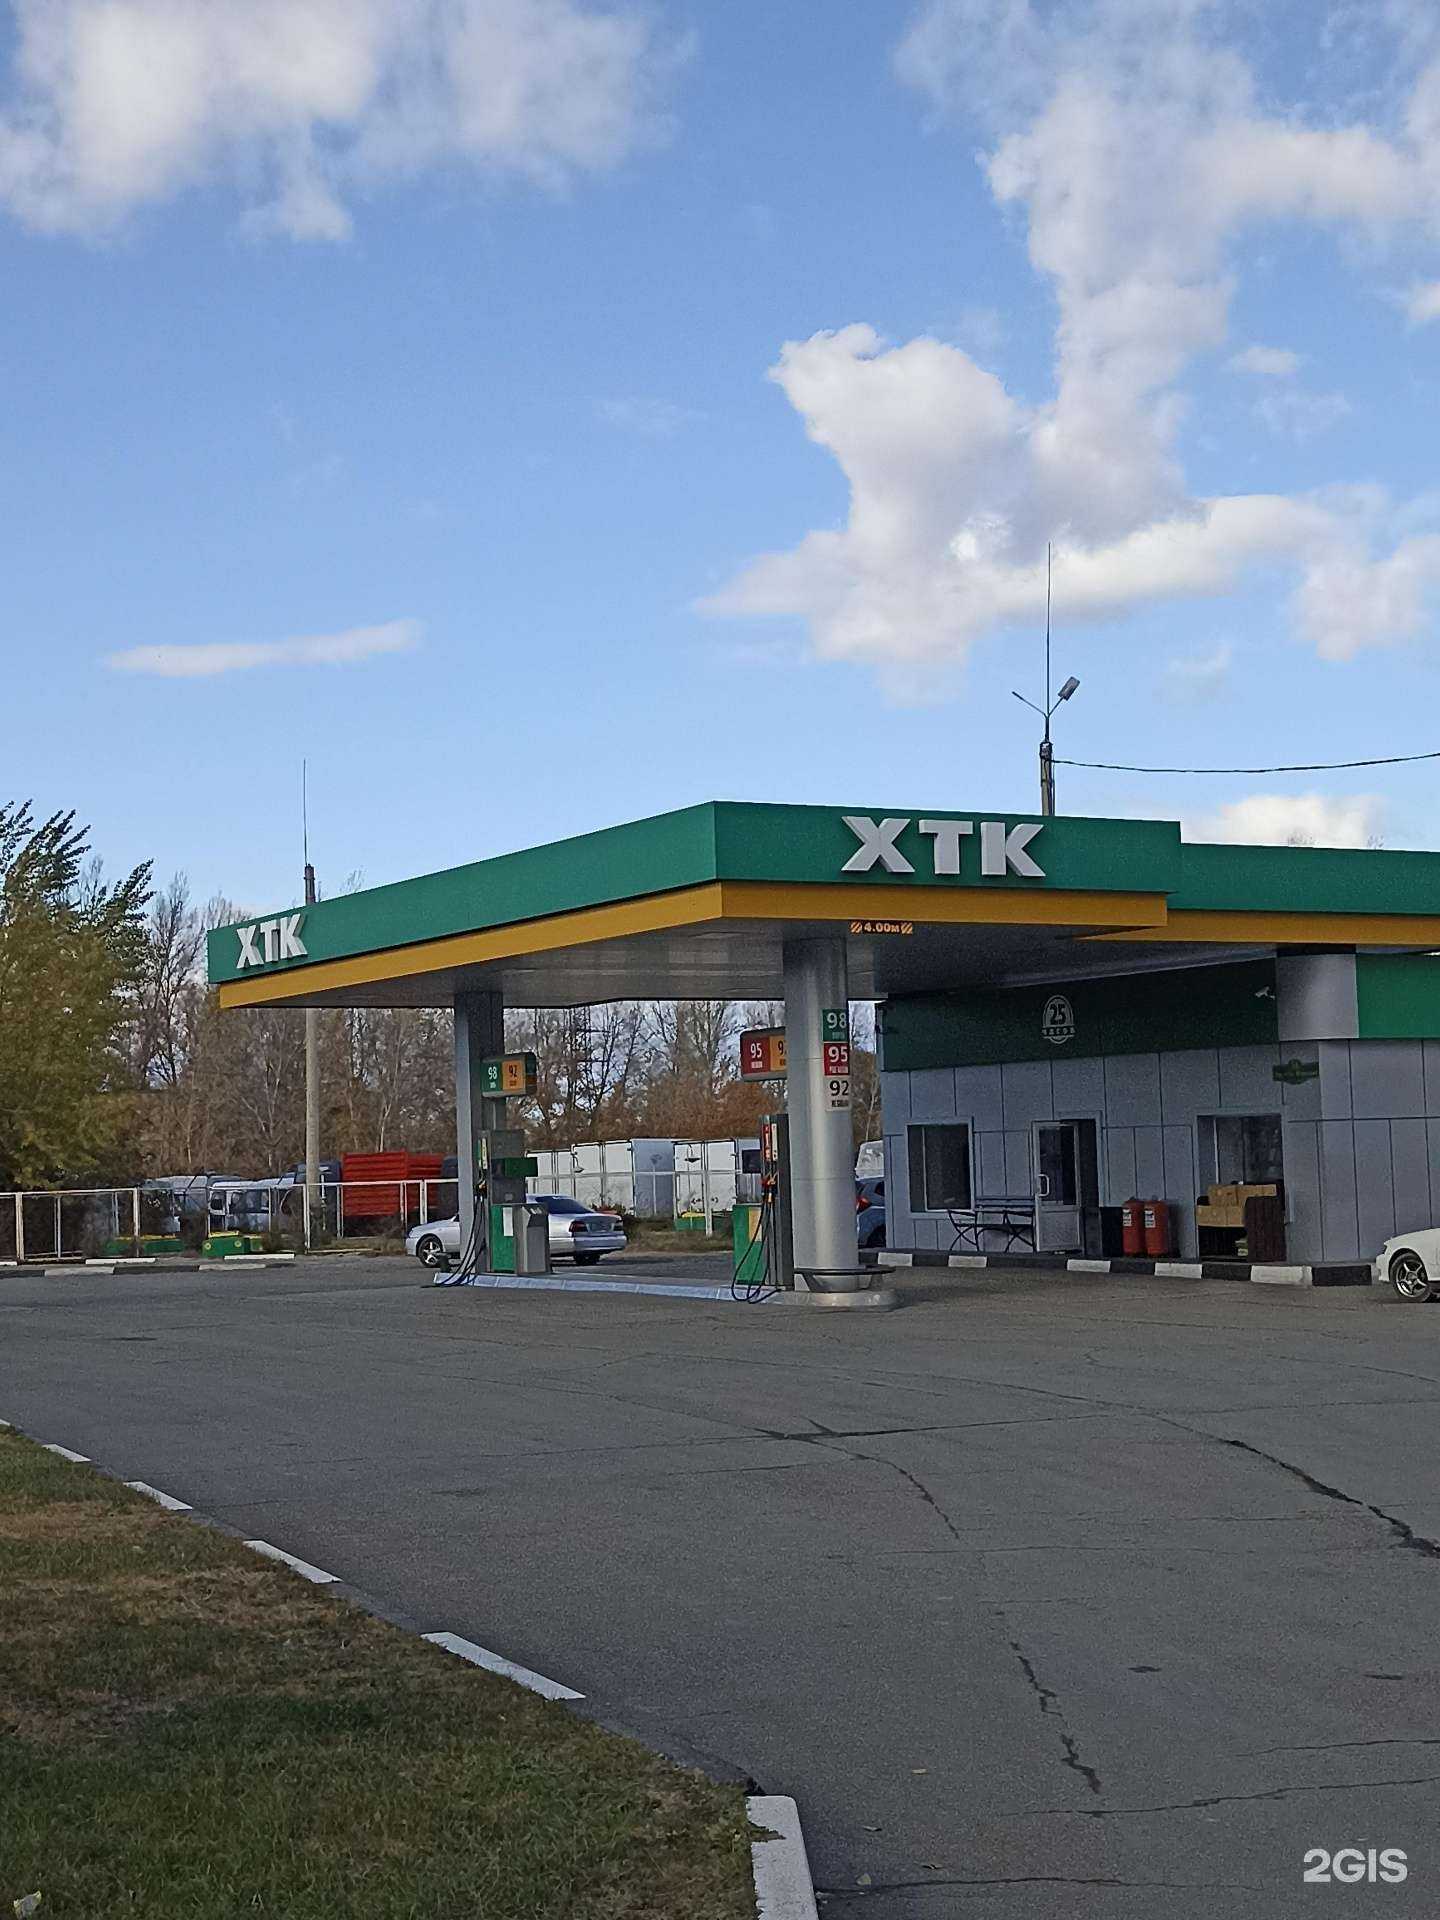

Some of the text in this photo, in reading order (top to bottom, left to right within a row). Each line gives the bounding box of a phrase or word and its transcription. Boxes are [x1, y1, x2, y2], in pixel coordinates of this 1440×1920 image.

[841, 816, 1046, 877] ХТК
[236, 913, 308, 969] ХТК
[827, 1012, 847, 1029] 98
[1050, 1003, 1067, 1025] 25
[750, 1042, 763, 1059] 95
[828, 1046, 848, 1063] 95
[487, 1066, 498, 1080] 98
[829, 1080, 850, 1097] 92
